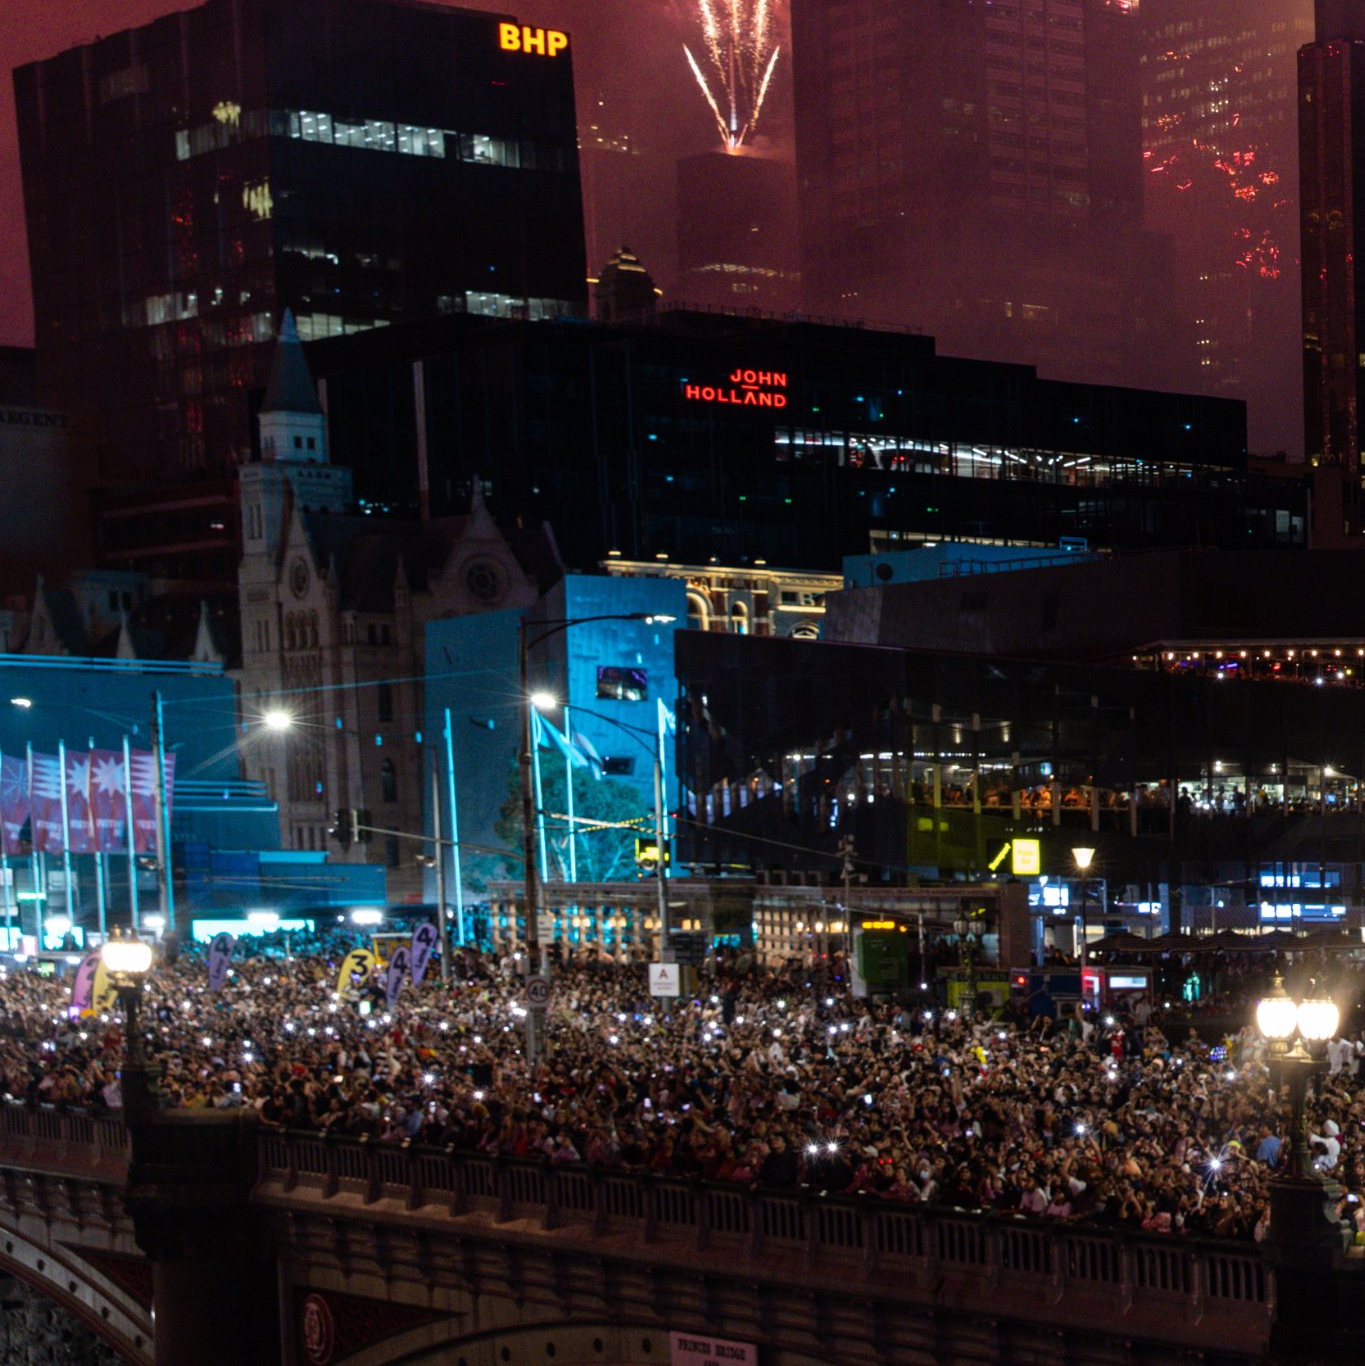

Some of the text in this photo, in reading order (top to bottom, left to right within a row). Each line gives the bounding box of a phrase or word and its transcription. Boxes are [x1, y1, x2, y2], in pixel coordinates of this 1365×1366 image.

[499, 22, 569, 57] BHP
[730, 369, 788, 388] JOHN
[685, 384, 788, 408] HOLLAND
[417, 927, 433, 946] 4
[351, 955, 368, 976] 3
[393, 950, 407, 974] 4
[659, 968, 669, 978] A
[530, 985, 548, 998] 40
